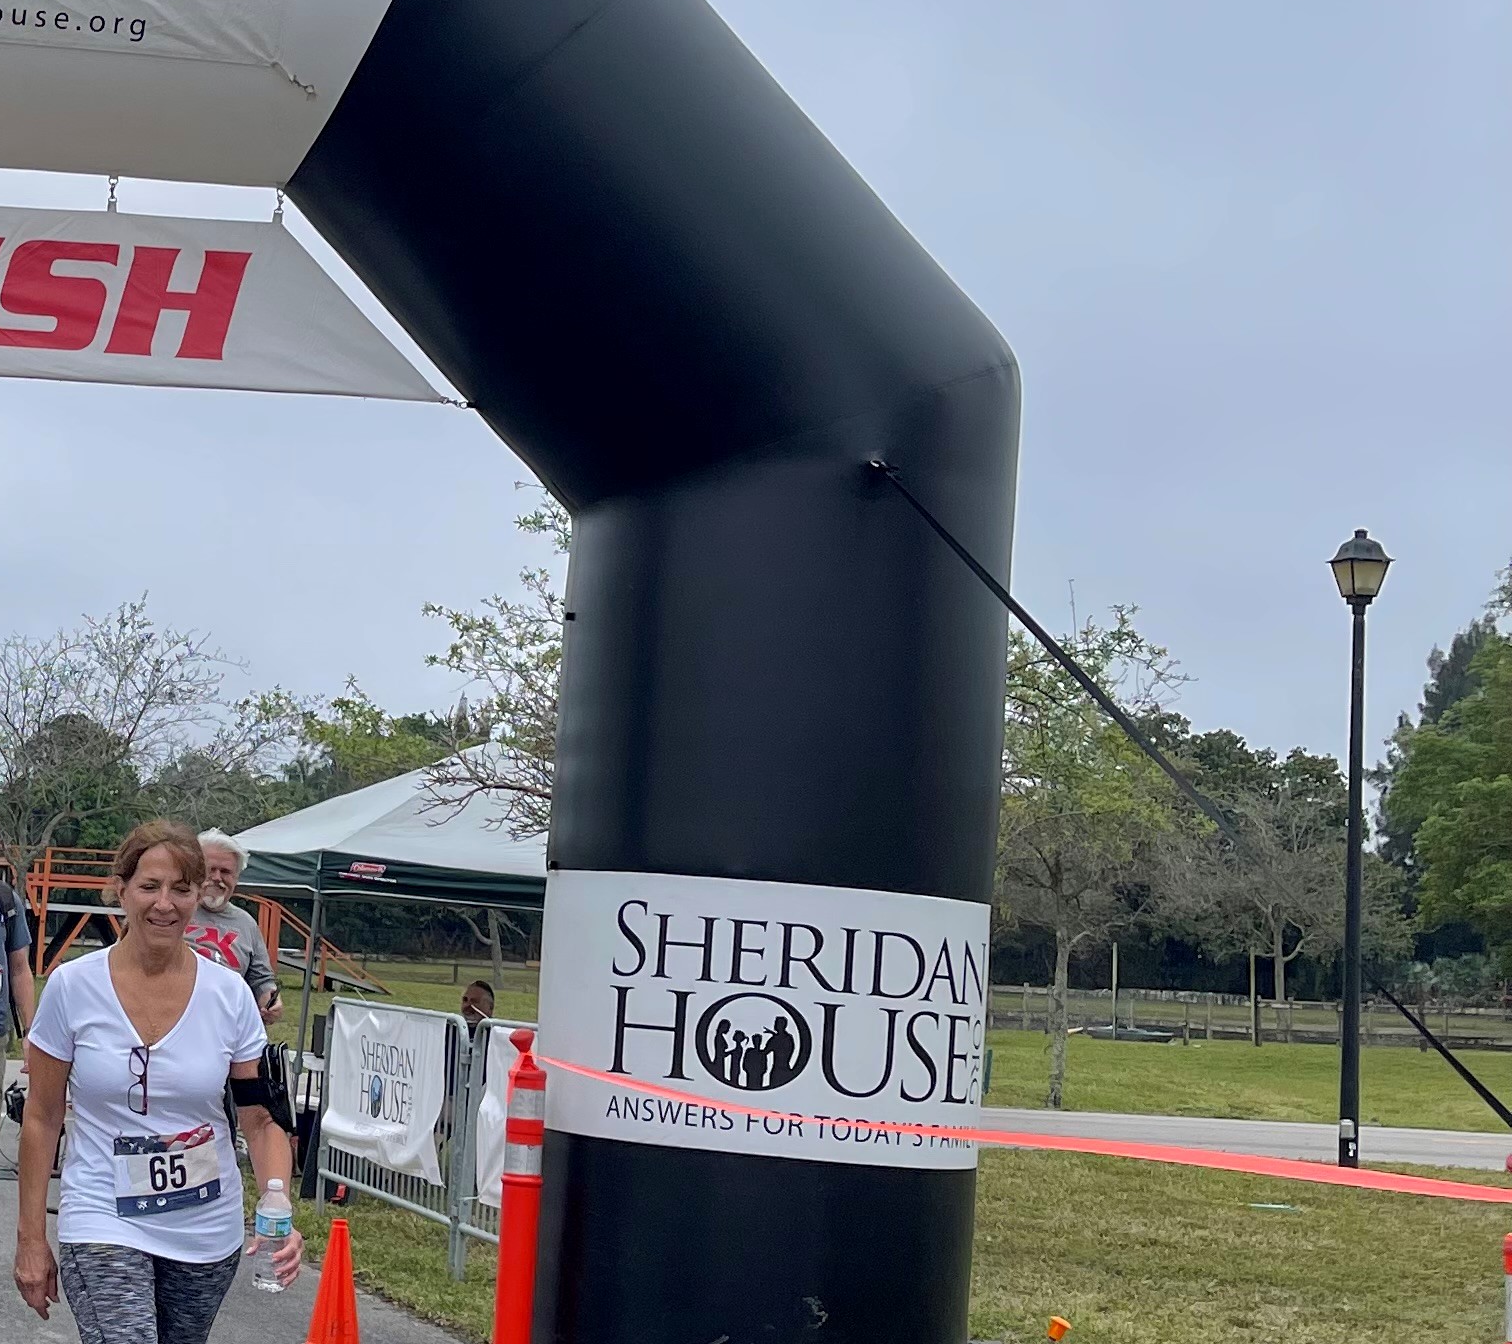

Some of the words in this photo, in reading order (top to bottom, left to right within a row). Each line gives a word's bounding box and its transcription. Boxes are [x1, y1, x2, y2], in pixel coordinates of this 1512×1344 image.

[613, 899, 986, 1007] SHERIDAN
[360, 1034, 416, 1080] SHERIDAN
[607, 985, 972, 1105] HOUSE
[359, 1072, 408, 1125] HOUSE
[605, 1095, 734, 1132] ANSWERS
[149, 1153, 187, 1192] 65
